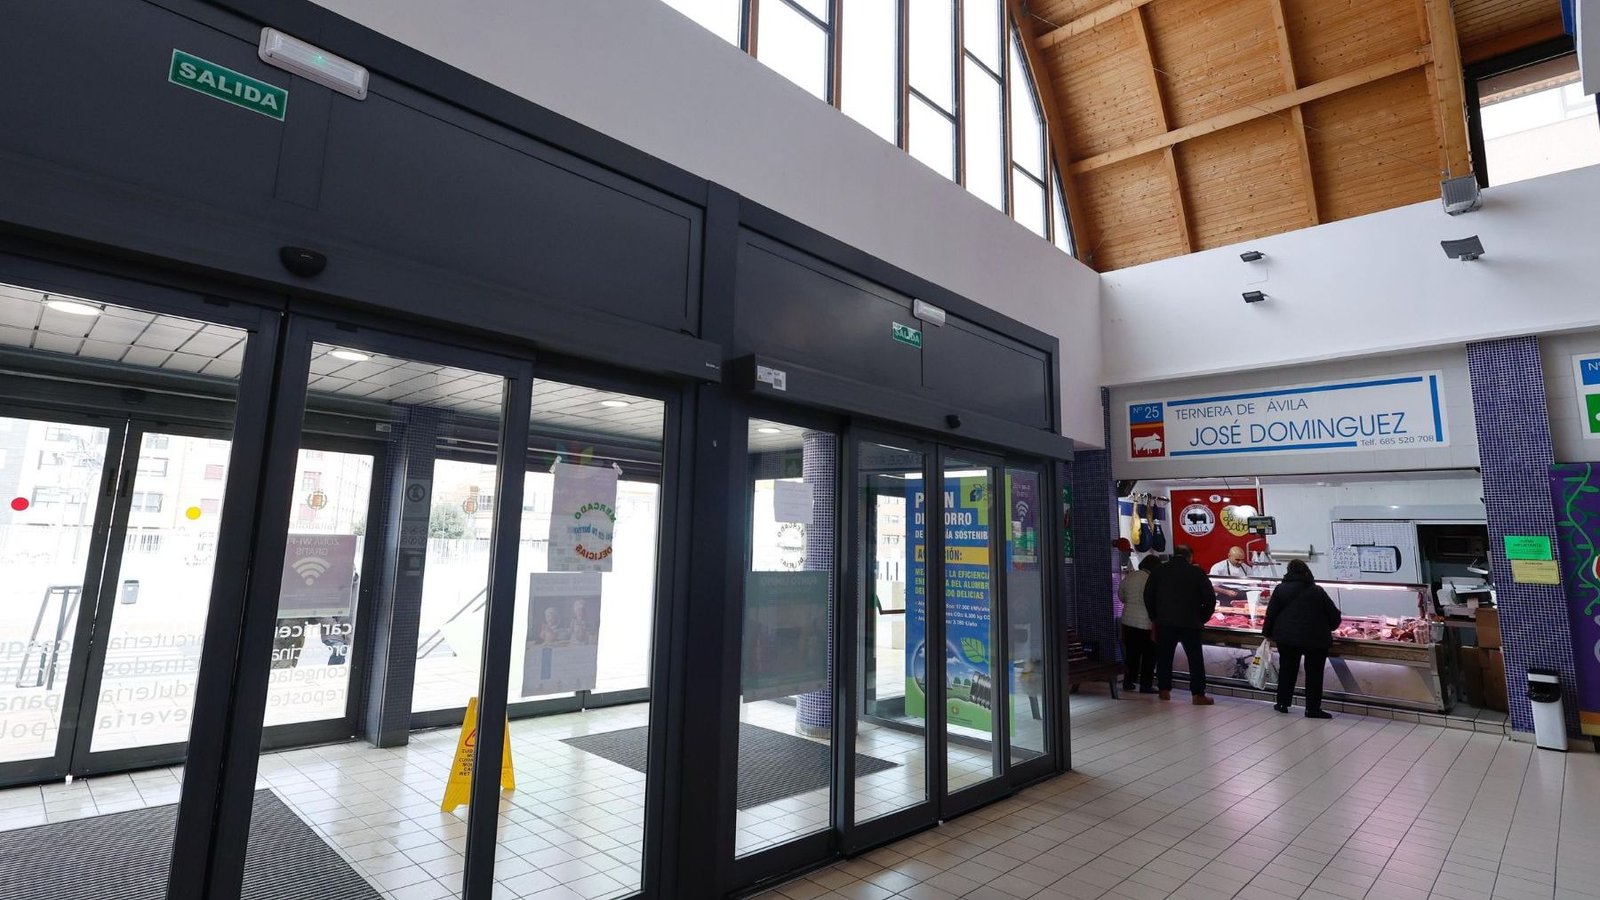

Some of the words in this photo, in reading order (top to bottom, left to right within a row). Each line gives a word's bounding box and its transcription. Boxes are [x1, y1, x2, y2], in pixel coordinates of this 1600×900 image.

[178, 62, 279, 111] SALIDA
[1145, 405, 1160, 419] 25
[1176, 405, 1233, 420] TERNERA
[1237, 402, 1255, 415] DE
[1267, 398, 1309, 412] ÁVILA
[1190, 419, 1241, 447] JOSÉ
[1250, 412, 1407, 443] DOMINGUEZ
[1360, 438, 1377, 447] Telf.
[1379, 437, 1396, 446] 685
[1398, 436, 1414, 444] 520
[954, 530, 989, 540] SOSTENIB
[956, 590, 984, 599] DELICIAS
